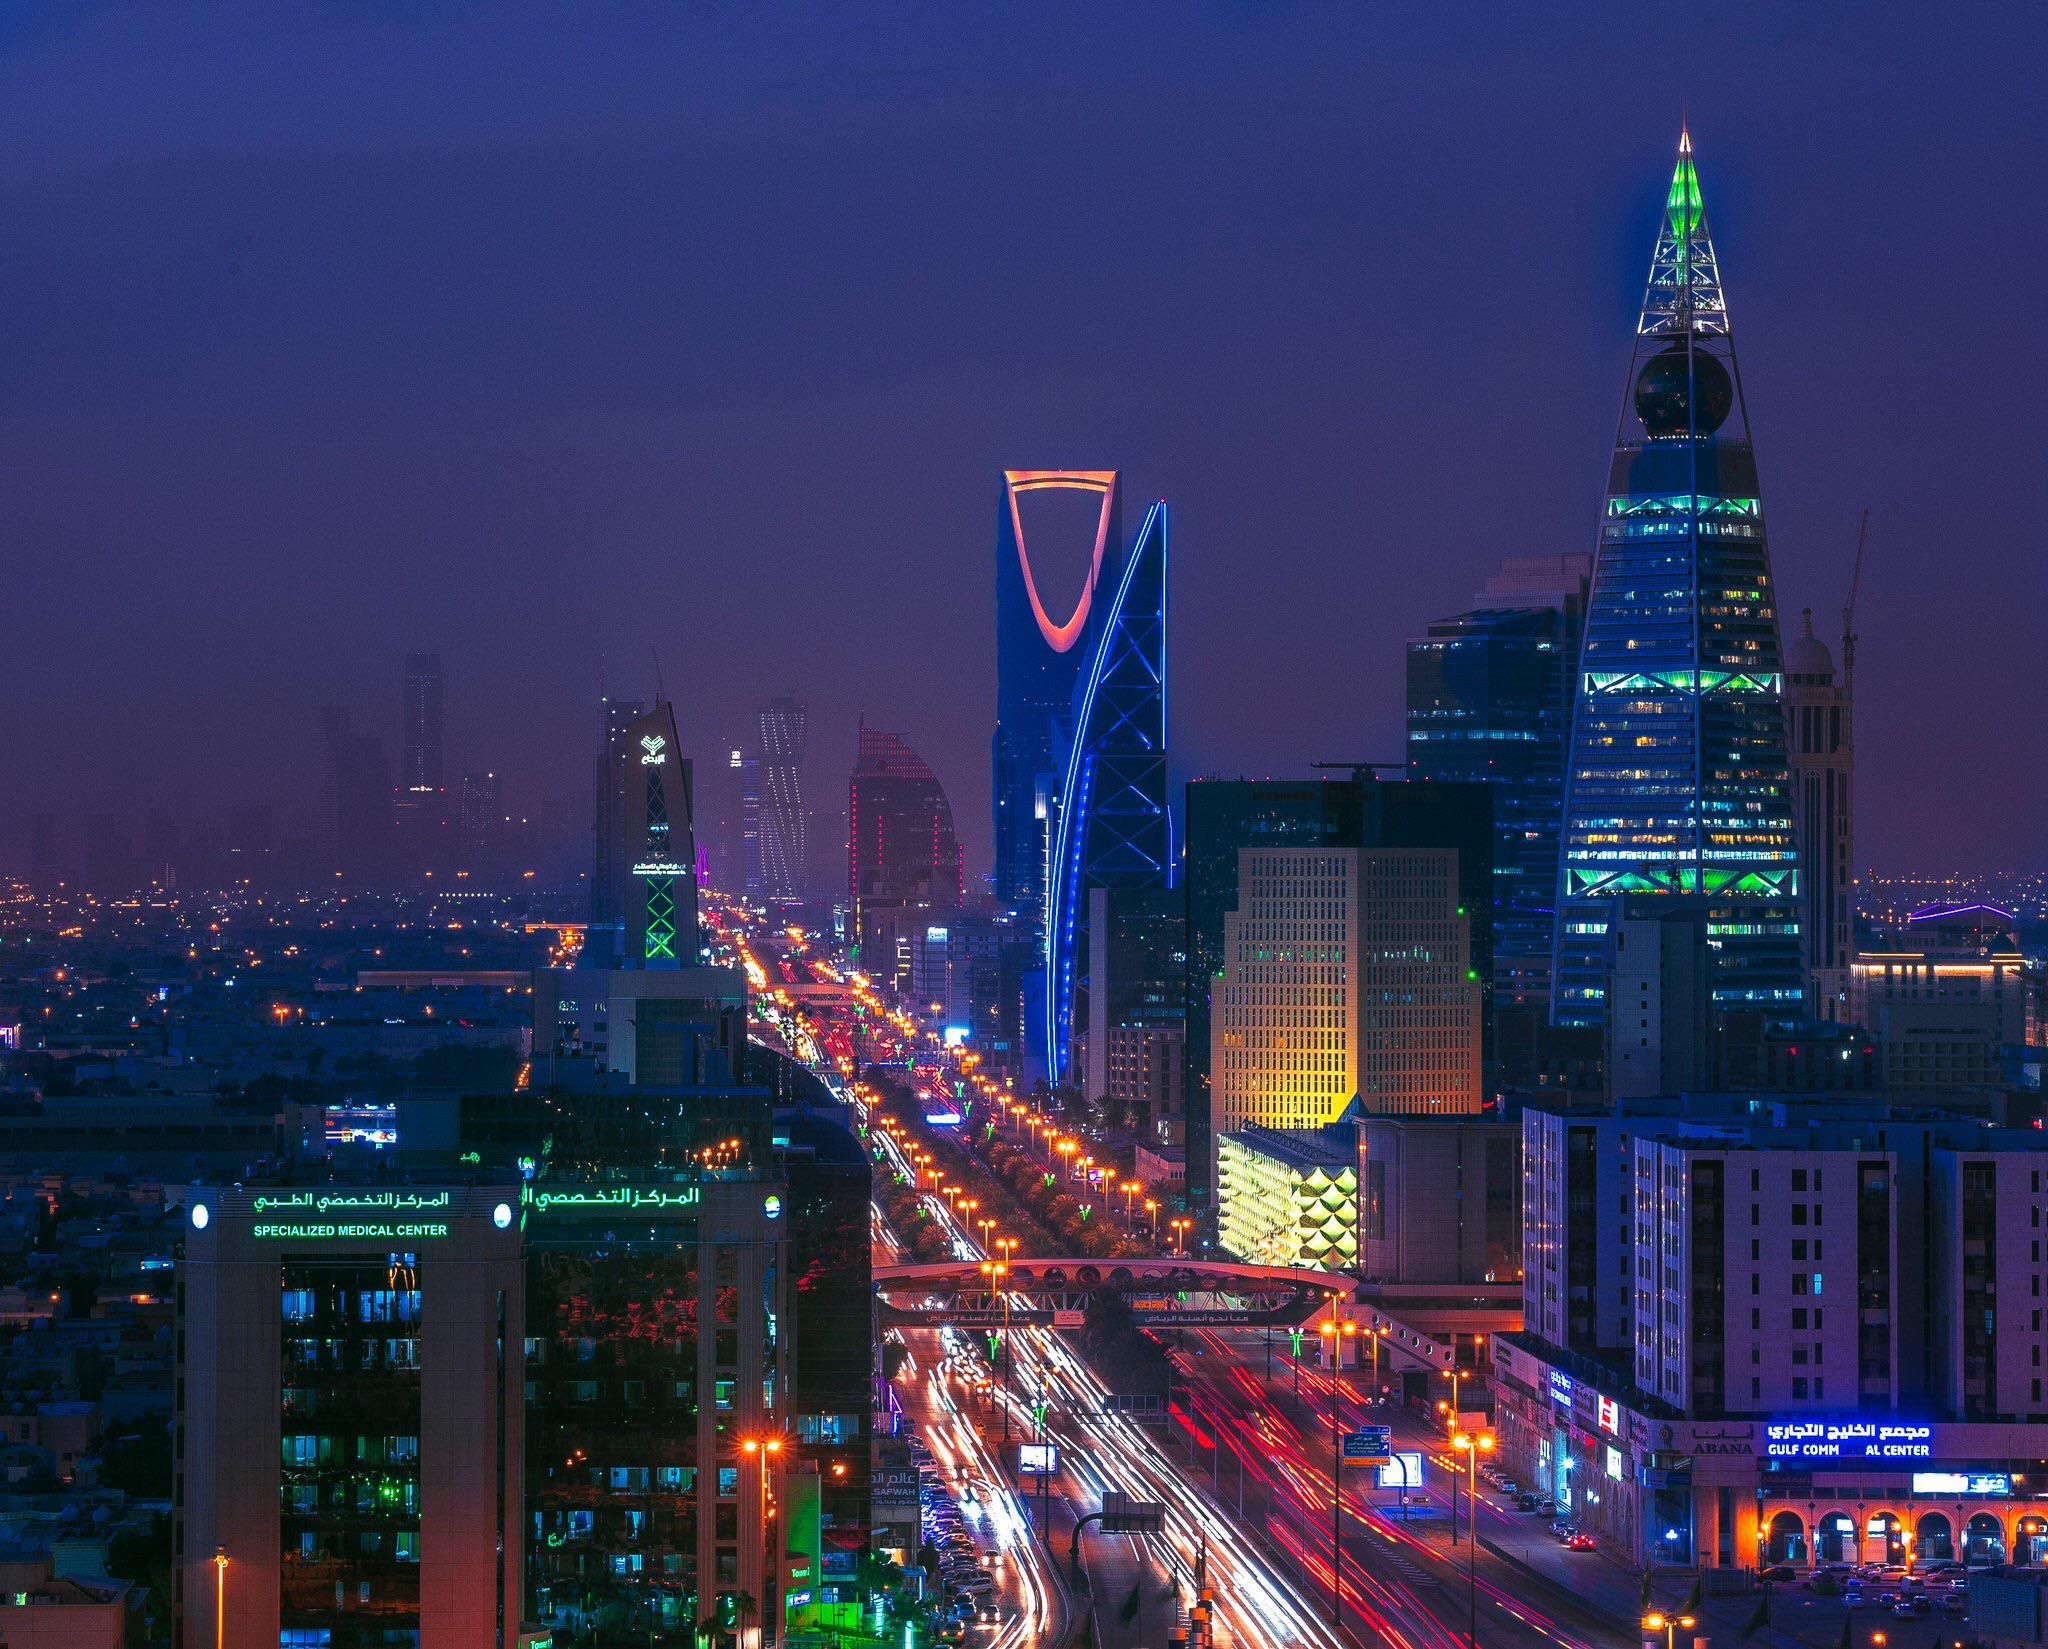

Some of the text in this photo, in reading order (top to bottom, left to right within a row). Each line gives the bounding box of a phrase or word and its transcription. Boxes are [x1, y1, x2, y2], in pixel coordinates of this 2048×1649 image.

[253, 1191, 449, 1213] المركز التخصصي الطبي
[535, 1187, 631, 1212] التخصصي
[631, 1186, 699, 1208] المركز
[254, 1225, 447, 1237] SPECIALIZED MEDICAL CENTER
[1768, 1423, 1930, 1440] مجمع الخليج التجاري
[1693, 1443, 1753, 1454] ABANA
[1768, 1444, 1799, 1456] GULF
[1883, 1445, 1929, 1456] CENTER
[887, 1472, 916, 1487] عالم
